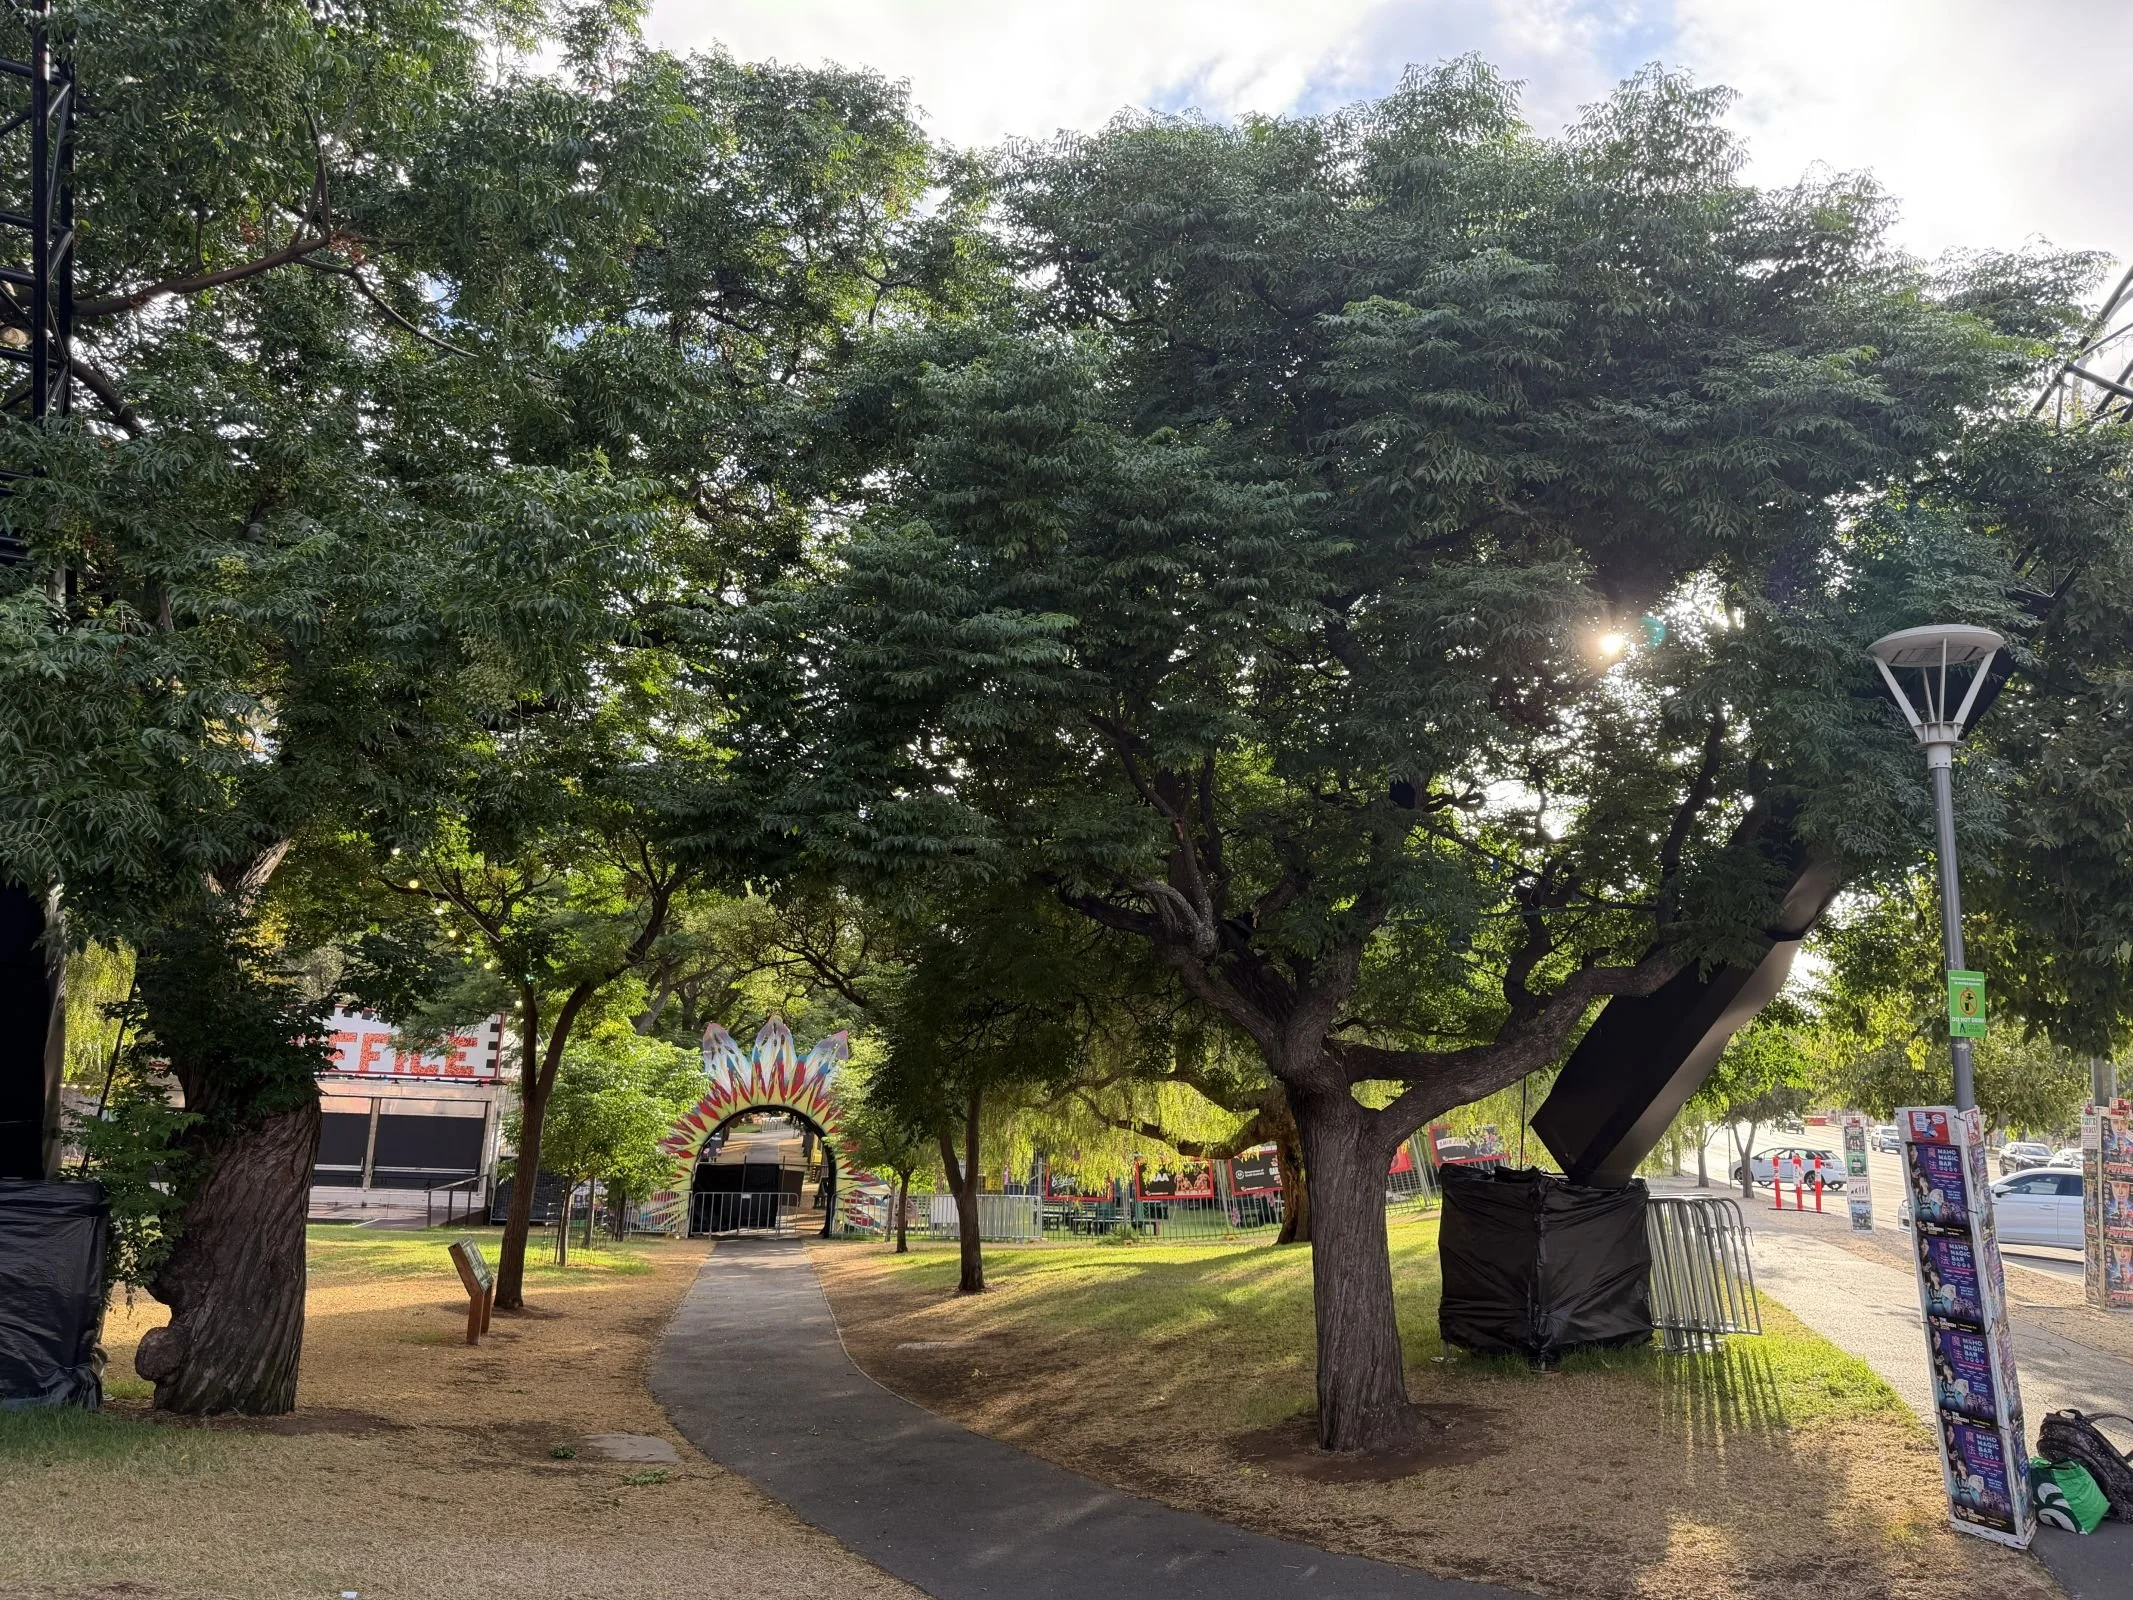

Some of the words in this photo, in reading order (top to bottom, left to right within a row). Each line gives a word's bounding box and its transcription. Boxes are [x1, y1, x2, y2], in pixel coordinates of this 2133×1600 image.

[290, 1031, 478, 1075] FFICE
[1963, 1338, 1982, 1346] MAHO
[1963, 1345, 1985, 1353] MAGIC
[1976, 1434, 1997, 1442] MAHO
[1977, 1441, 2000, 1450] MAGIC
[1978, 1447, 1993, 1455] BAR
